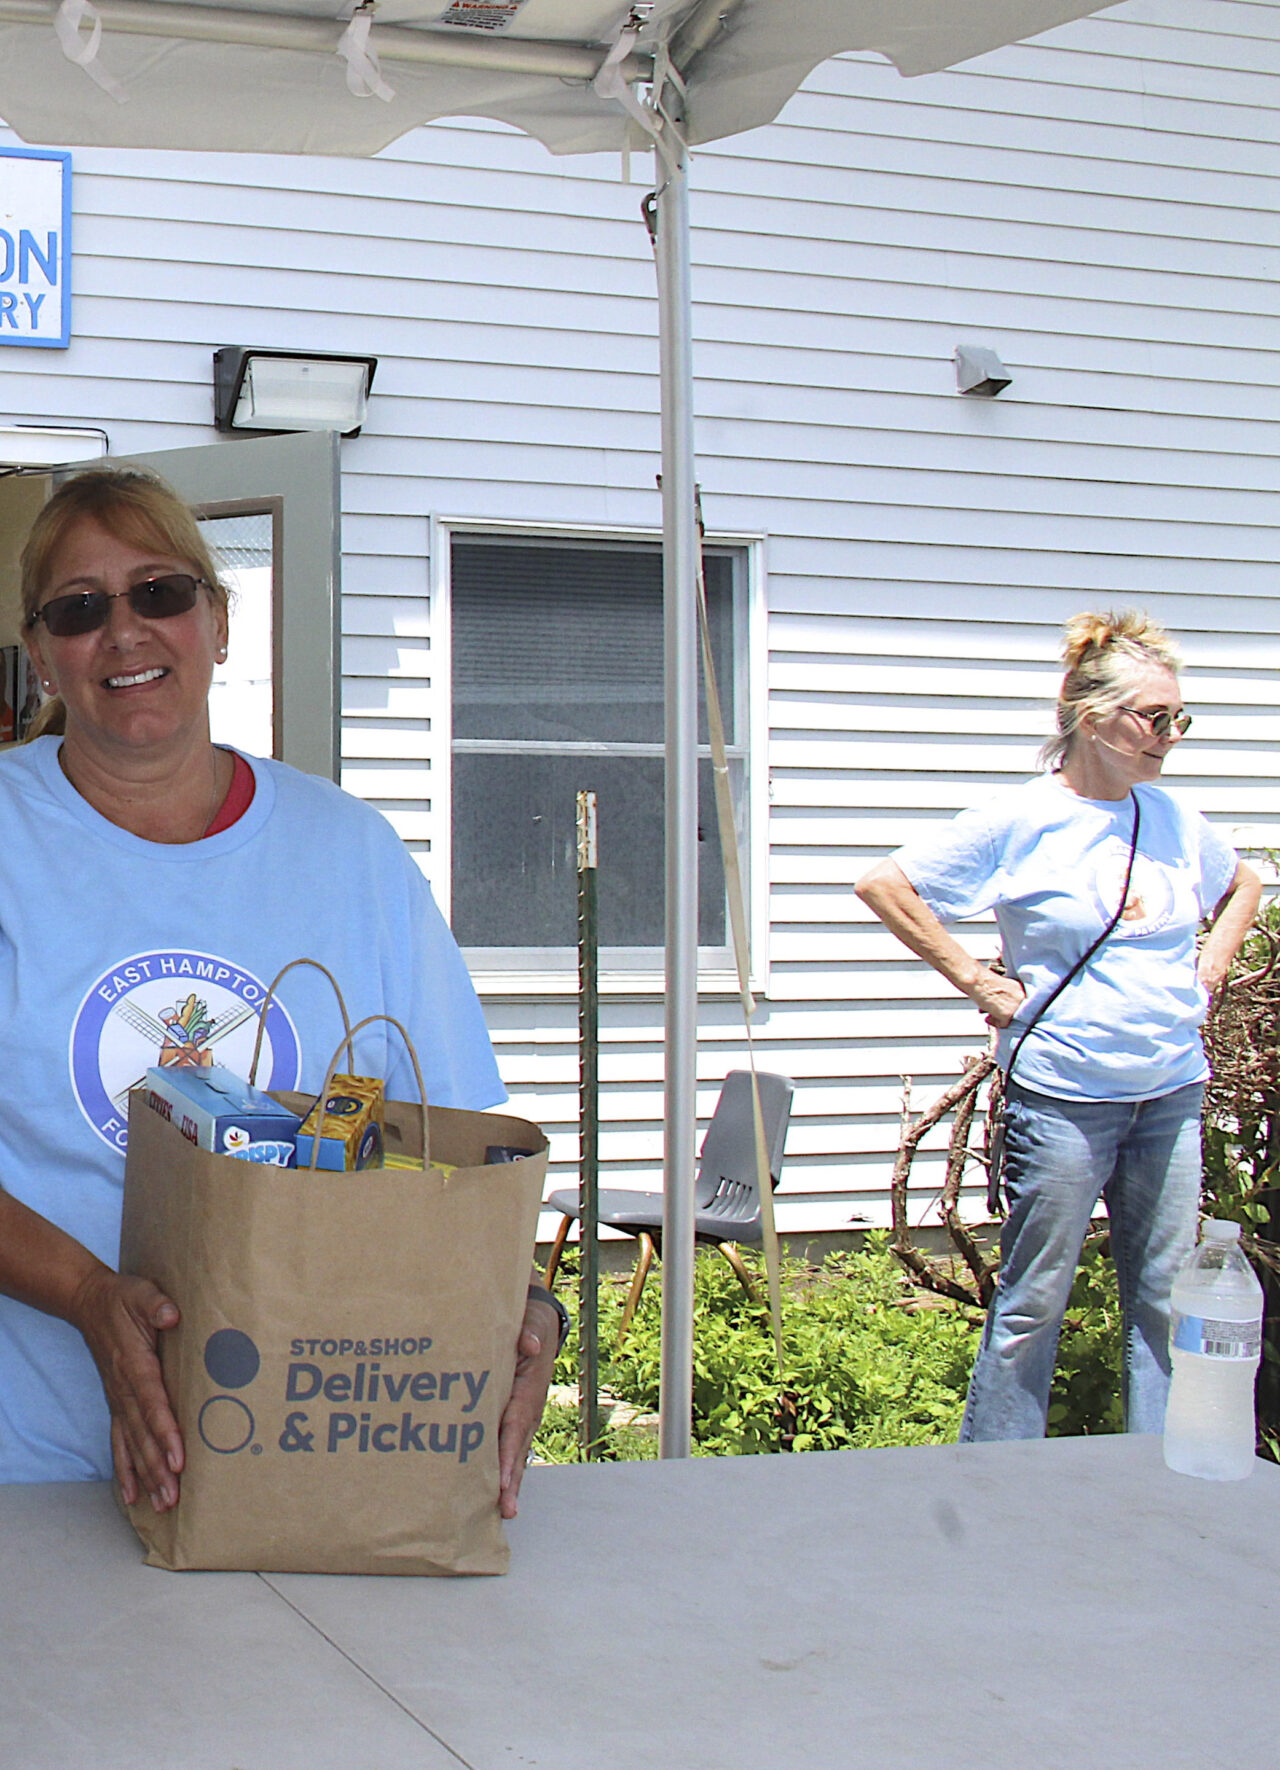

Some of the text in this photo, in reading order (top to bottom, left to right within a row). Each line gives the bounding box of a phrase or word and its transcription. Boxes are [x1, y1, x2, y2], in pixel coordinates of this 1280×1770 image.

[98, 957, 274, 1014] EAST HAMPTON
[101, 1117, 128, 1146] FO
[180, 1114, 199, 1147] USA
[290, 1337, 433, 1357] STOP&SHOP
[285, 1363, 490, 1413] Delivery
[278, 1411, 485, 1464] & Pickup
